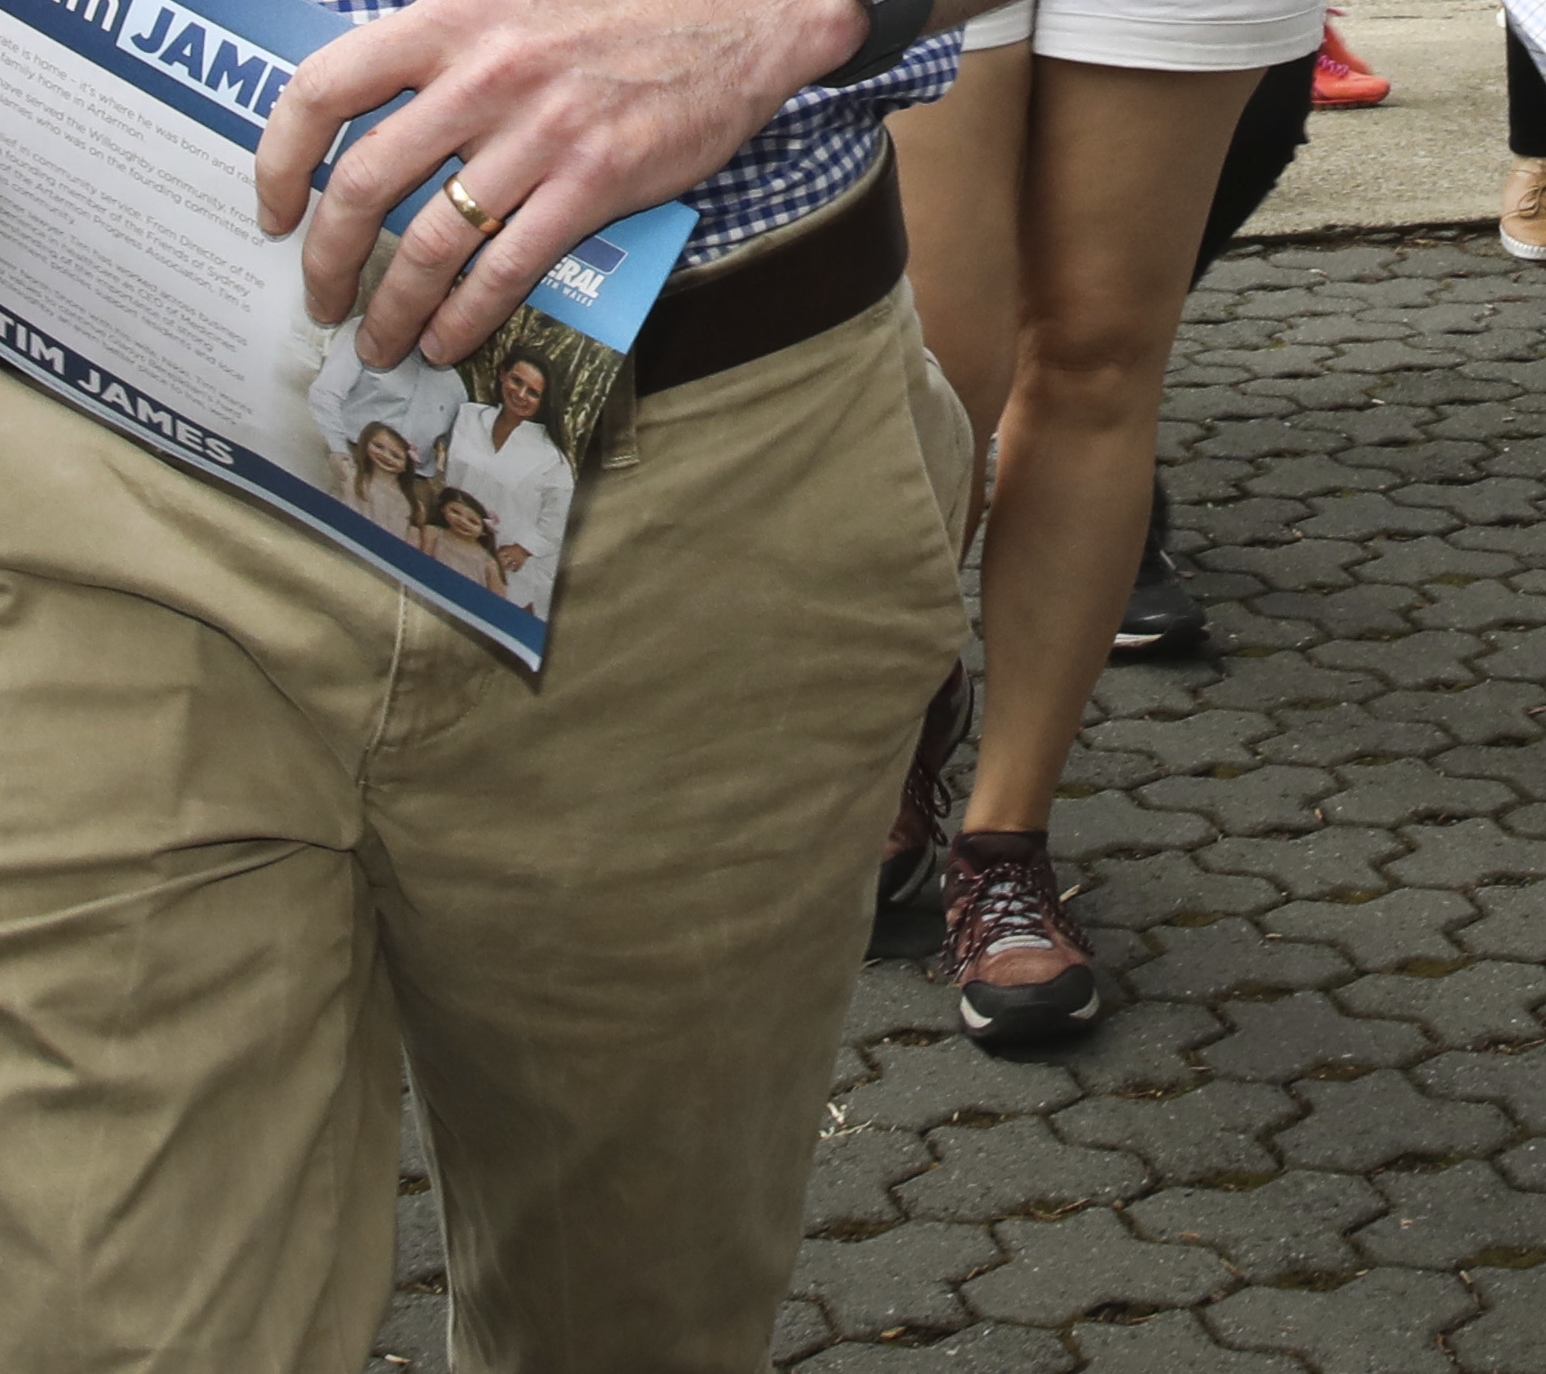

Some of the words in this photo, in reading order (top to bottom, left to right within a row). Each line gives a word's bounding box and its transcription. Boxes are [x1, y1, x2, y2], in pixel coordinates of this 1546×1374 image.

[20, 46, 33, 60] is
[31, 53, 69, 80] home
[97, 90, 137, 119] where
[135, 112, 154, 129] he
[154, 125, 179, 144] was
[178, 137, 211, 162] born
[210, 155, 235, 176] and
[36, 73, 73, 100] home
[72, 94, 86, 108] in
[131, 6, 296, 117] JAME
[23, 91, 66, 121] served
[64, 114, 88, 134] the
[85, 126, 157, 173] Willoughby
[34, 113, 63, 135] who
[61, 130, 87, 150] was
[87, 145, 104, 160] on
[105, 153, 128, 172] the
[126, 166, 183, 205] founding
[183, 197, 250, 240] committee
[249, 233, 265, 248] of
[19, 143, 31, 156] in
[31, 150, 97, 195] community
[144, 214, 178, 240] From
[178, 234, 227, 268] Director
[228, 262, 243, 277] of
[243, 271, 265, 290] the
[78, 367, 235, 465] JAMES
